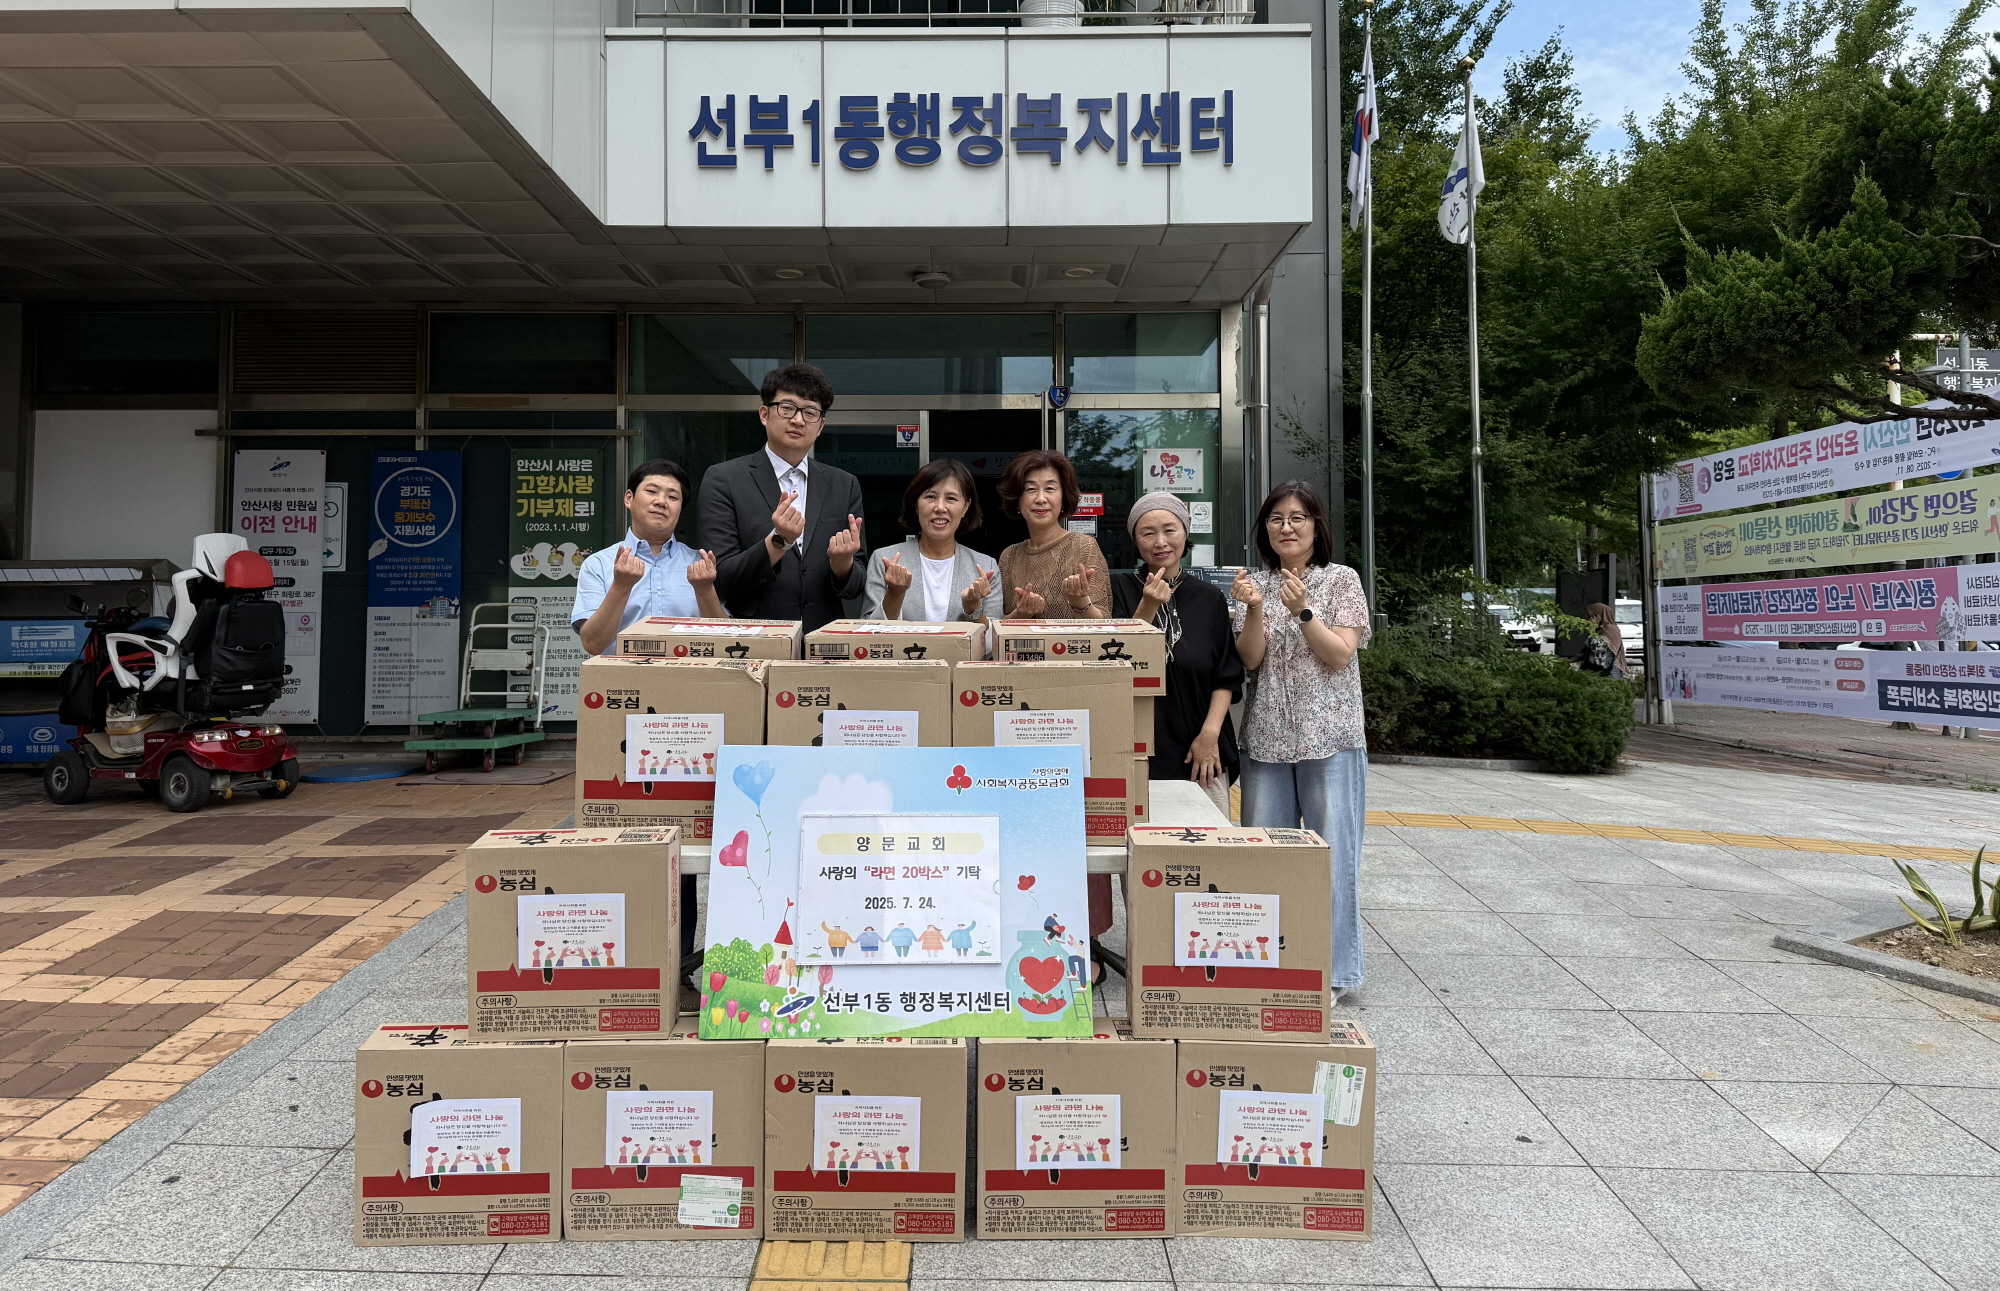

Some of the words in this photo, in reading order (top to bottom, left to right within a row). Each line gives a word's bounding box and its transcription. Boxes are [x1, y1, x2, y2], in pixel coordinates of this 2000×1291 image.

[689, 91, 1233, 170] 선부1동행정복지센터
[517, 459, 552, 471] 안산시
[556, 459, 592, 471] 사랑은
[517, 475, 594, 494] 고향사랑
[400, 486, 431, 496] 경기도
[241, 500, 282, 511] 안산시청
[287, 500, 317, 511] 민원실
[400, 499, 431, 510] 부동산
[517, 498, 594, 517] 기부제로!
[394, 512, 436, 522] 중개보수
[241, 515, 275, 533] 이전
[282, 515, 316, 533] 안내
[526, 523, 589, 532] (2023.1.1.시행)
[394, 525, 435, 535] 지원사업
[690, 647, 714, 657] 농심
[870, 649, 893, 658] 농심
[1067, 645, 1091, 654] 농심
[606, 696, 640, 709] 농심
[797, 694, 830, 707] 농심
[981, 693, 1013, 705] 농심
[1032, 768, 1069, 776] 사랑의열매
[976, 778, 1069, 789] 사회복지공동모금회
[819, 866, 857, 880] 사랑의
[956, 865, 981, 881] 기탁
[499, 877, 536, 891] 농심
[1165, 873, 1200, 887] 농심
[864, 896, 897, 910] 2025.
[903, 897, 913, 909] 7.
[918, 896, 936, 909] 24.
[481, 997, 512, 1006] 주의사항
[824, 991, 892, 1014] 선부1동
[900, 990, 1011, 1013] 행정복지센터
[1146, 992, 1175, 1001] 주의사항
[612, 1017, 658, 1025] 080-023-5181
[594, 1074, 631, 1088] 농심
[1008, 1077, 1044, 1091] 농심
[1209, 1073, 1245, 1087] 농심
[386, 1083, 424, 1097] 농심
[798, 1079, 834, 1093] 농심
[430, 1115, 459, 1123] 사랑의
[1188, 1191, 1218, 1199] 주의사항
[989, 1197, 1019, 1206] 주의사항
[366, 1204, 398, 1213] 주의사항
[501, 1221, 548, 1229] 080-023-5181
[1317, 1216, 1362, 1224] 080-023-5181
